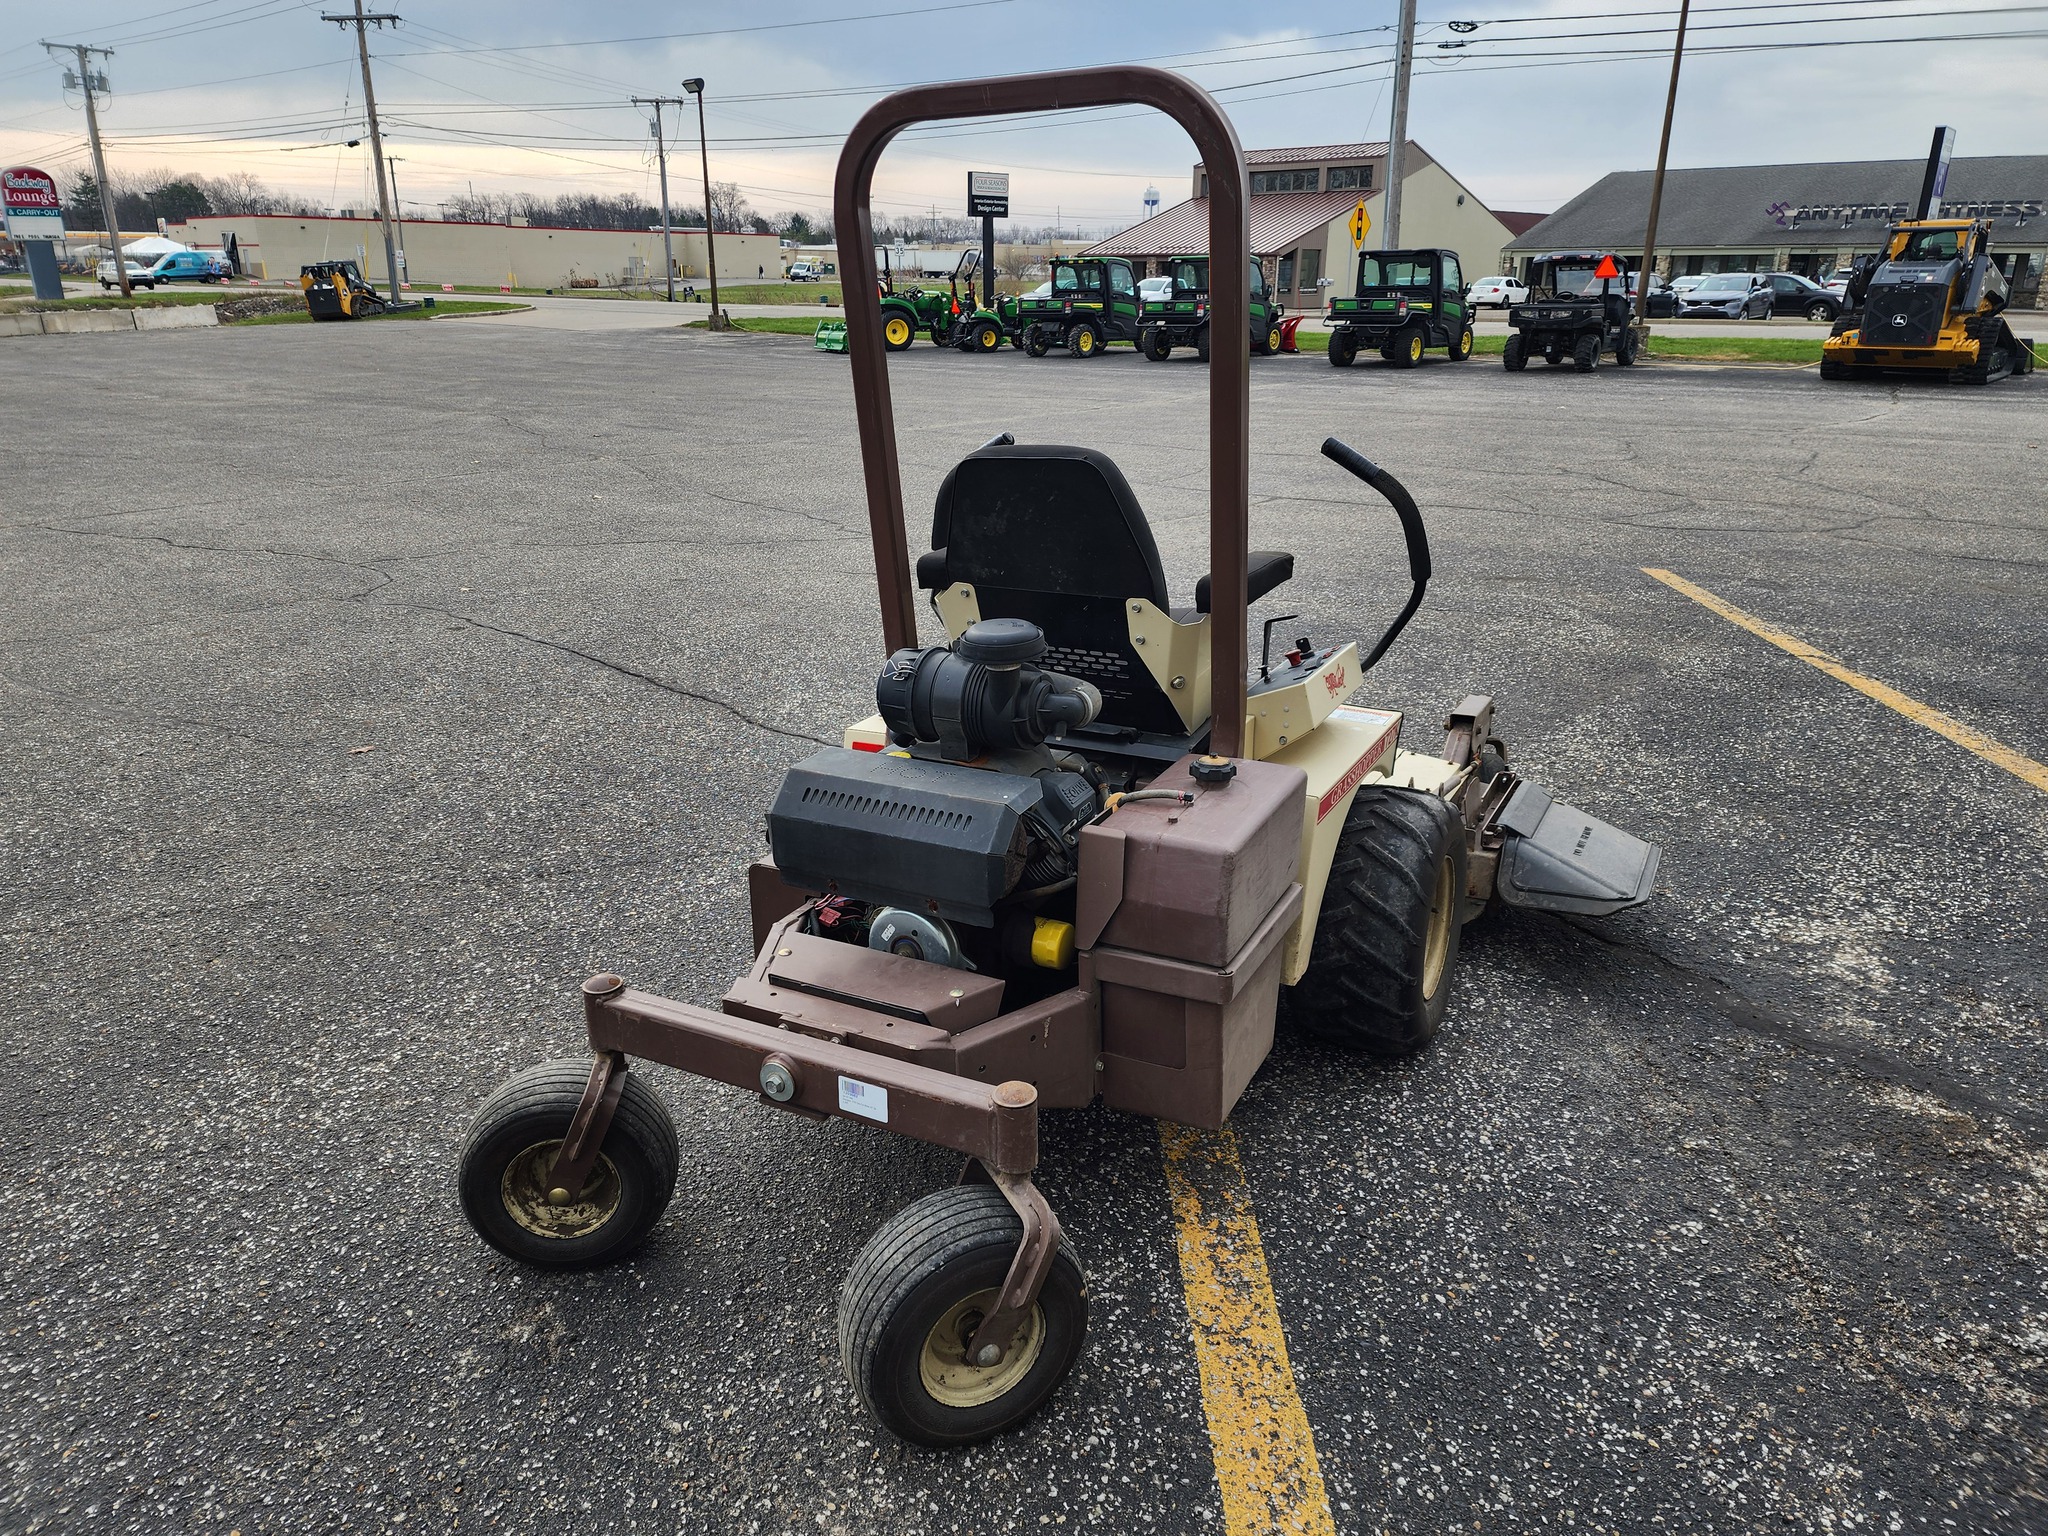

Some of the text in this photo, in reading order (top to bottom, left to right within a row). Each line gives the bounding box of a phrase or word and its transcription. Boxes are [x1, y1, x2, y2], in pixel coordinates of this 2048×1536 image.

[5, 173, 50, 193] Backway
[4, 189, 56, 205] Lounge
[1795, 200, 2043, 220] ANYTIME FITNESS
[870, 762, 956, 783] HOT
[1331, 742, 1382, 804] GRASSHOPPER
